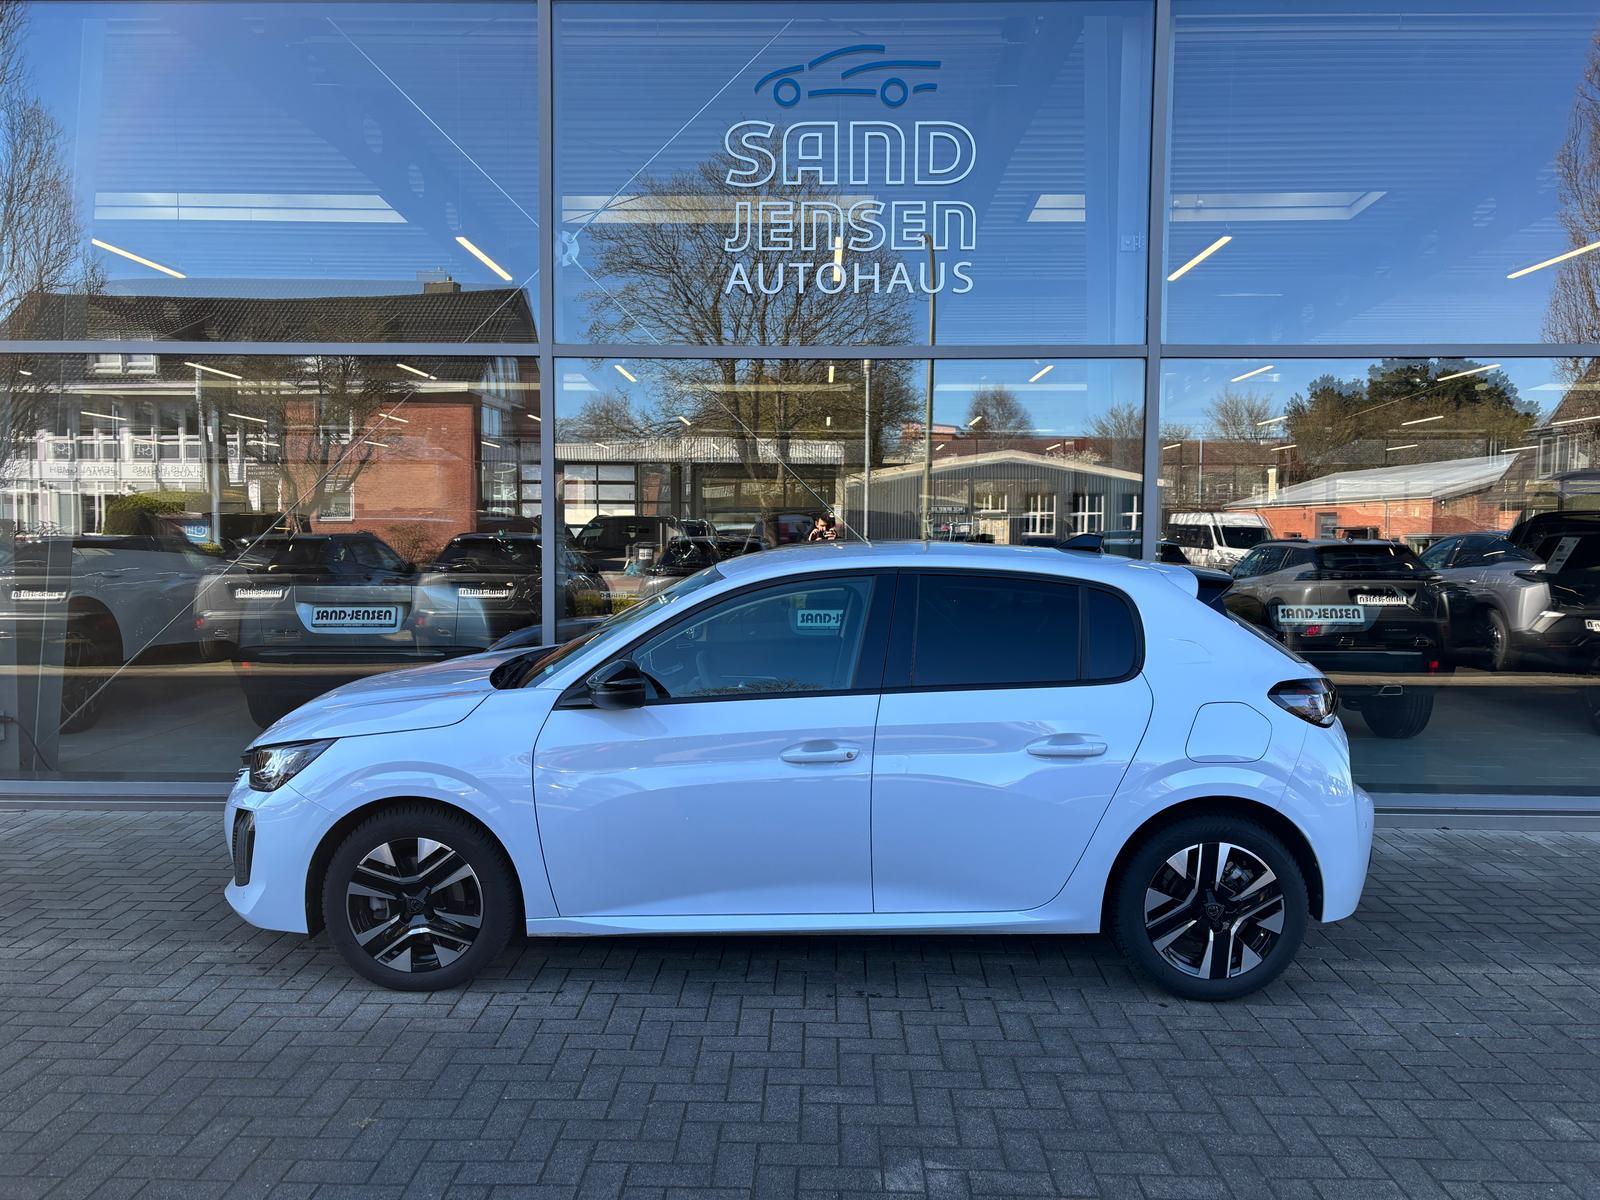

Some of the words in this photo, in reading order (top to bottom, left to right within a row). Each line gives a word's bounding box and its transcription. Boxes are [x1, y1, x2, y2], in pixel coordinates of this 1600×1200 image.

[725, 120, 977, 187] SAND
[725, 201, 977, 252] JENSEN
[725, 262, 975, 294] AUTOHAUS
